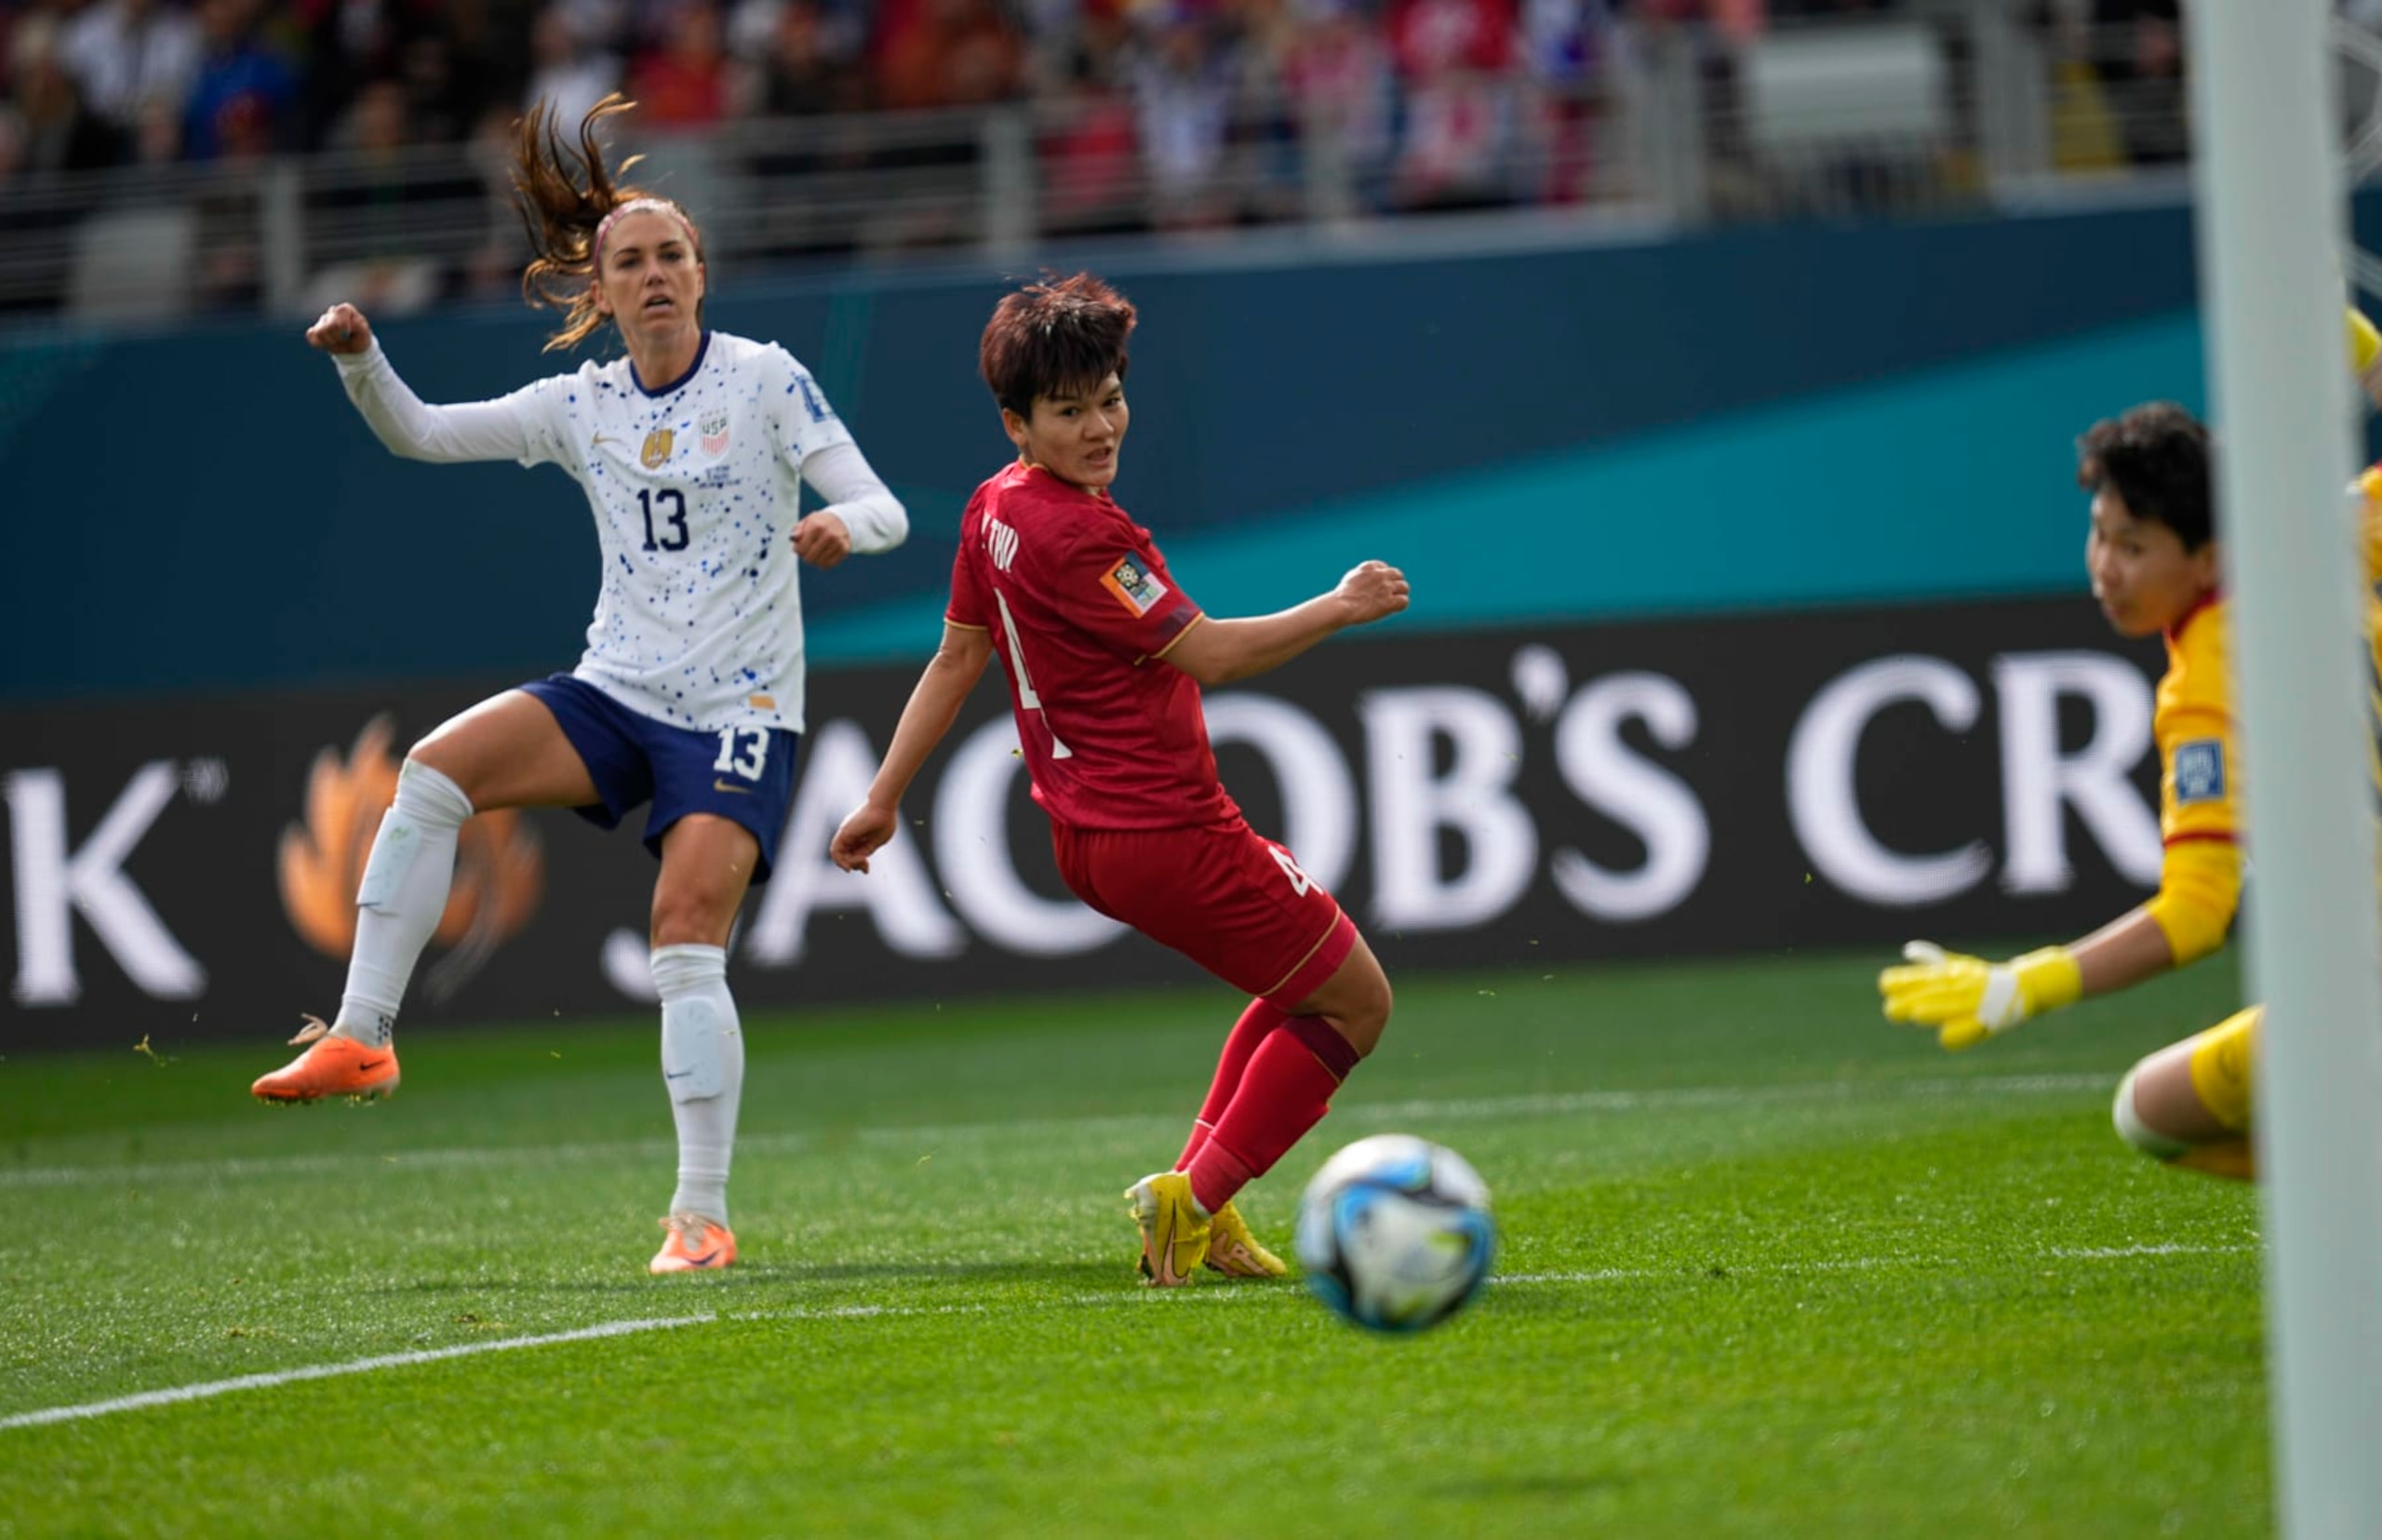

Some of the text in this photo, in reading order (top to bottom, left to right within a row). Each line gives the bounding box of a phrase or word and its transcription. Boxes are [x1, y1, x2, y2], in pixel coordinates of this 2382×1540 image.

[636, 488, 689, 552] 13
[714, 726, 770, 781] 13
[1268, 845, 1324, 898] 4
